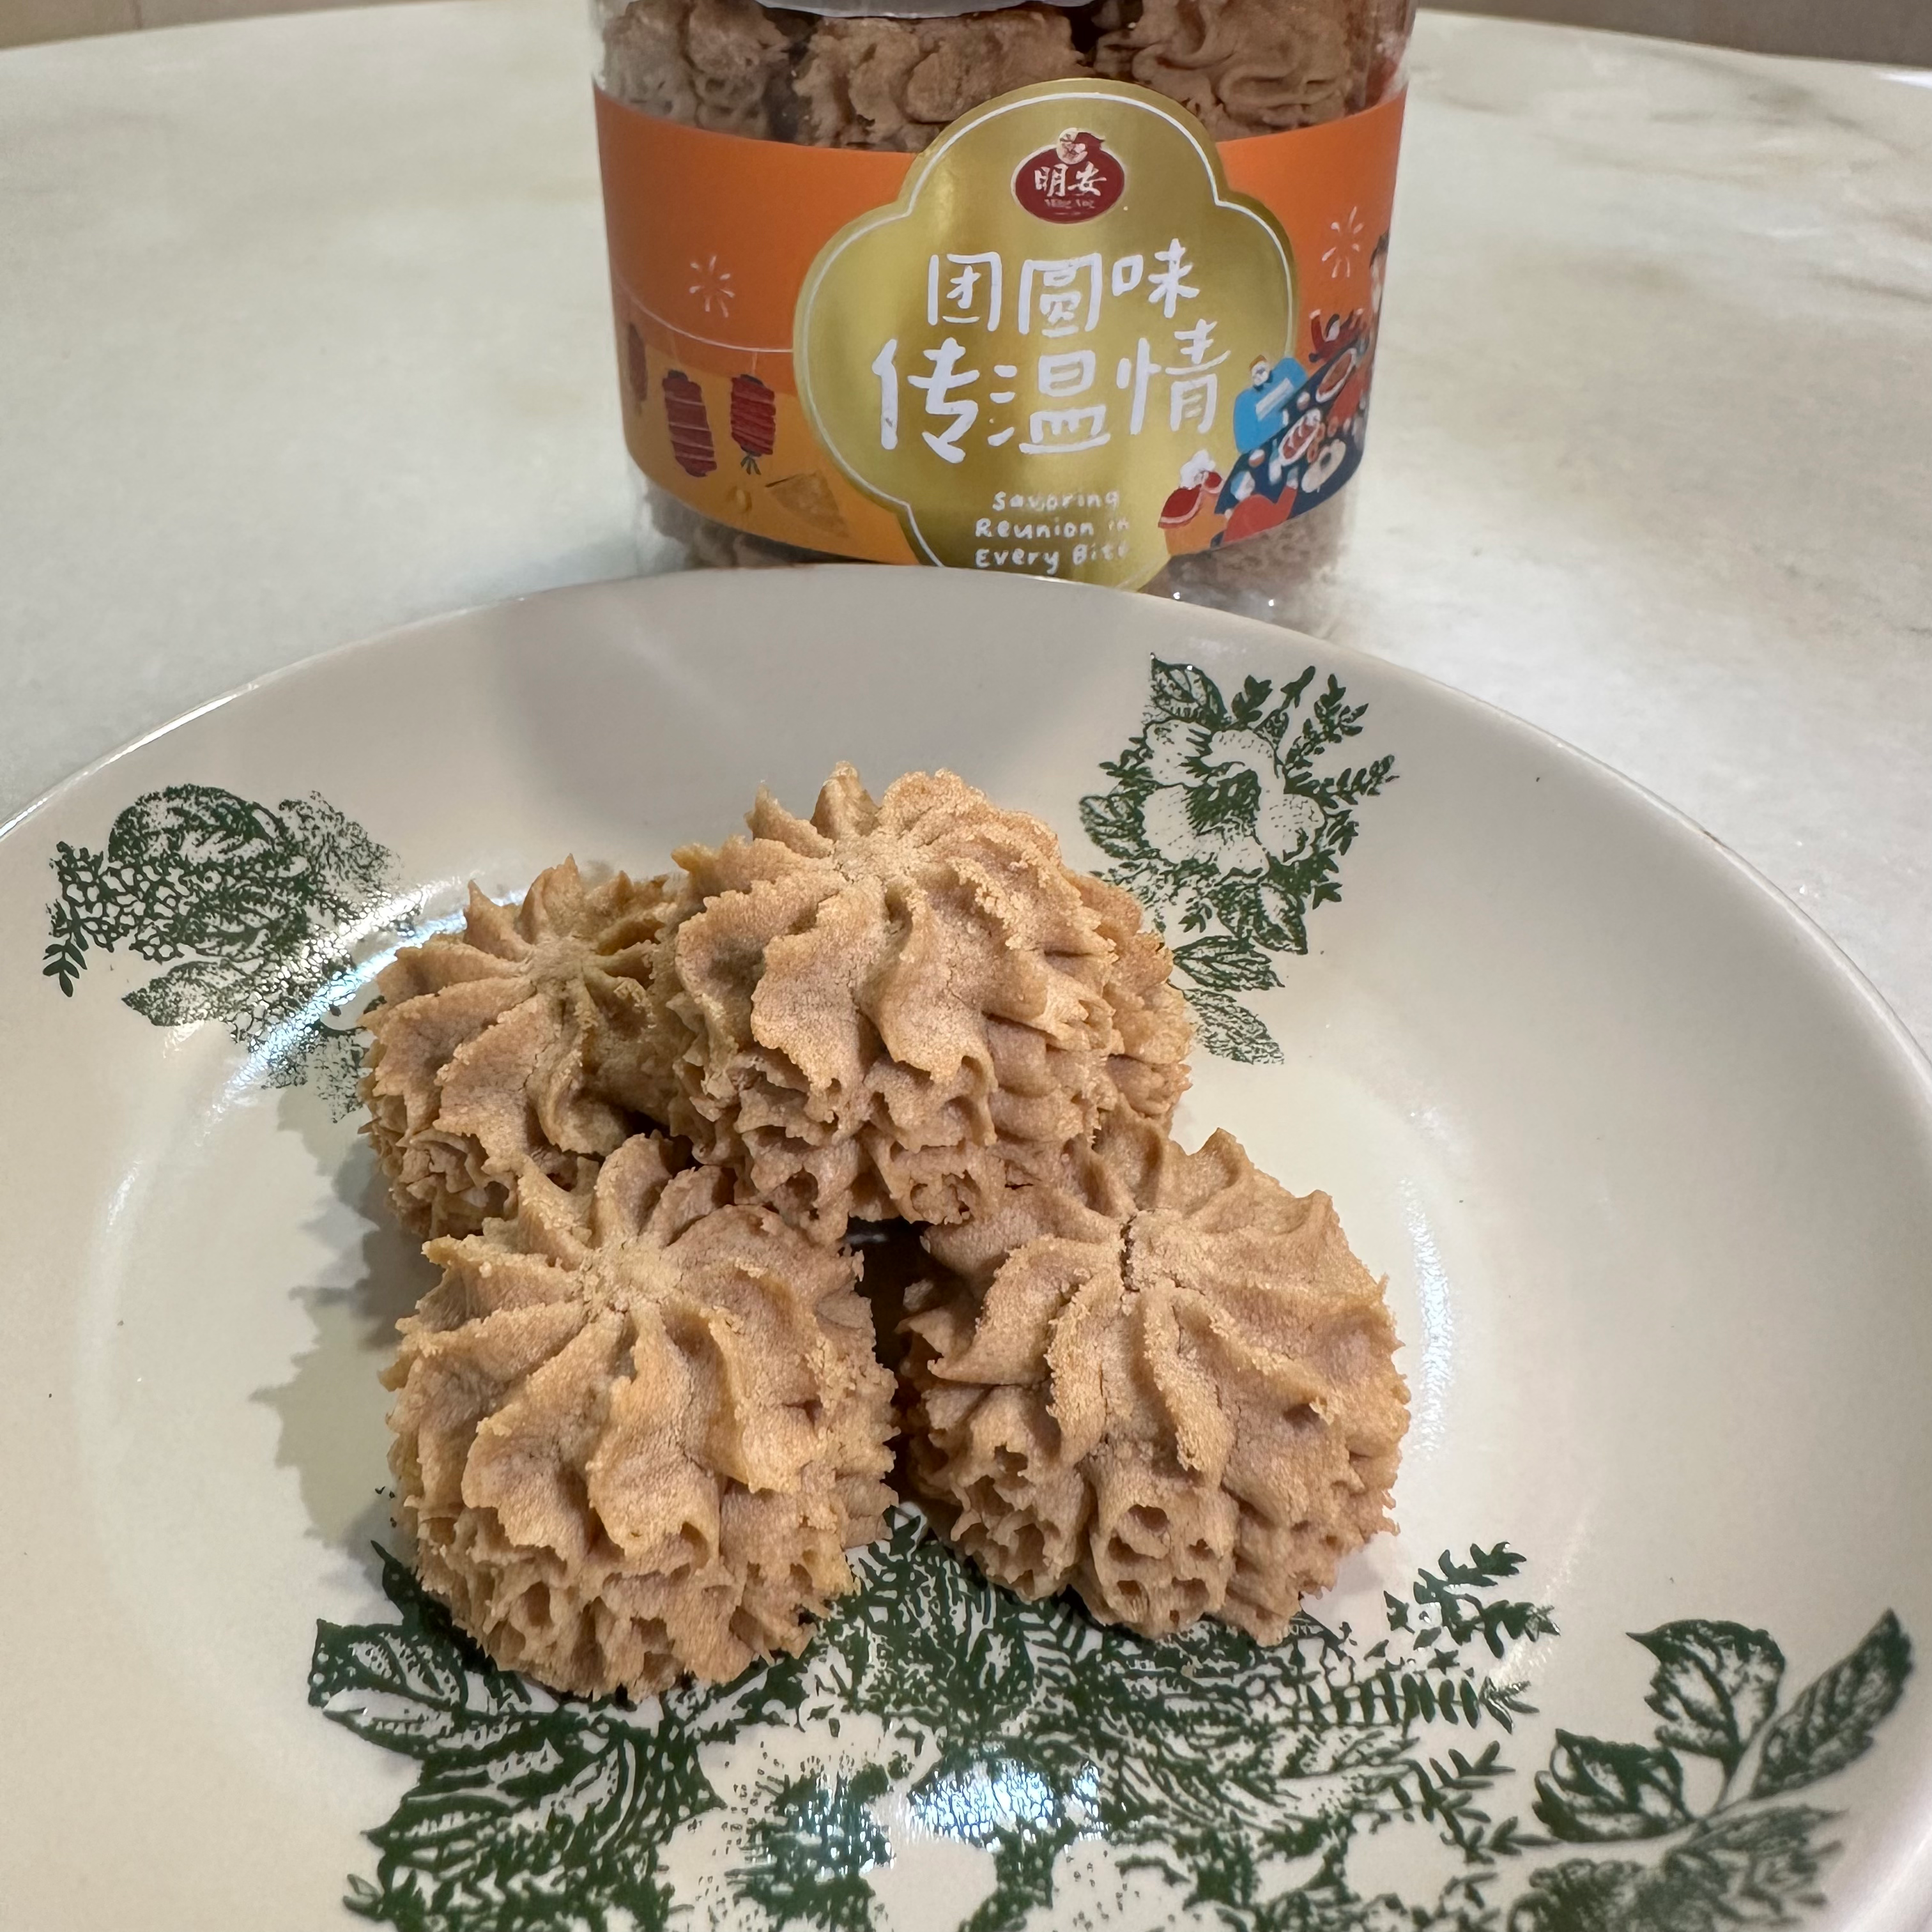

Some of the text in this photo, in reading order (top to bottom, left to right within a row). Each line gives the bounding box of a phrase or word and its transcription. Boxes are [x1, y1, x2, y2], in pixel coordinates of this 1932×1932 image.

[1034, 161, 1107, 197] 明安
[927, 238, 1200, 337] 团圆味
[871, 319, 1230, 464] 传温情
[992, 490, 1119, 512] Savoring
[975, 517, 1094, 539] Reunion
[975, 548, 1059, 575] Every
